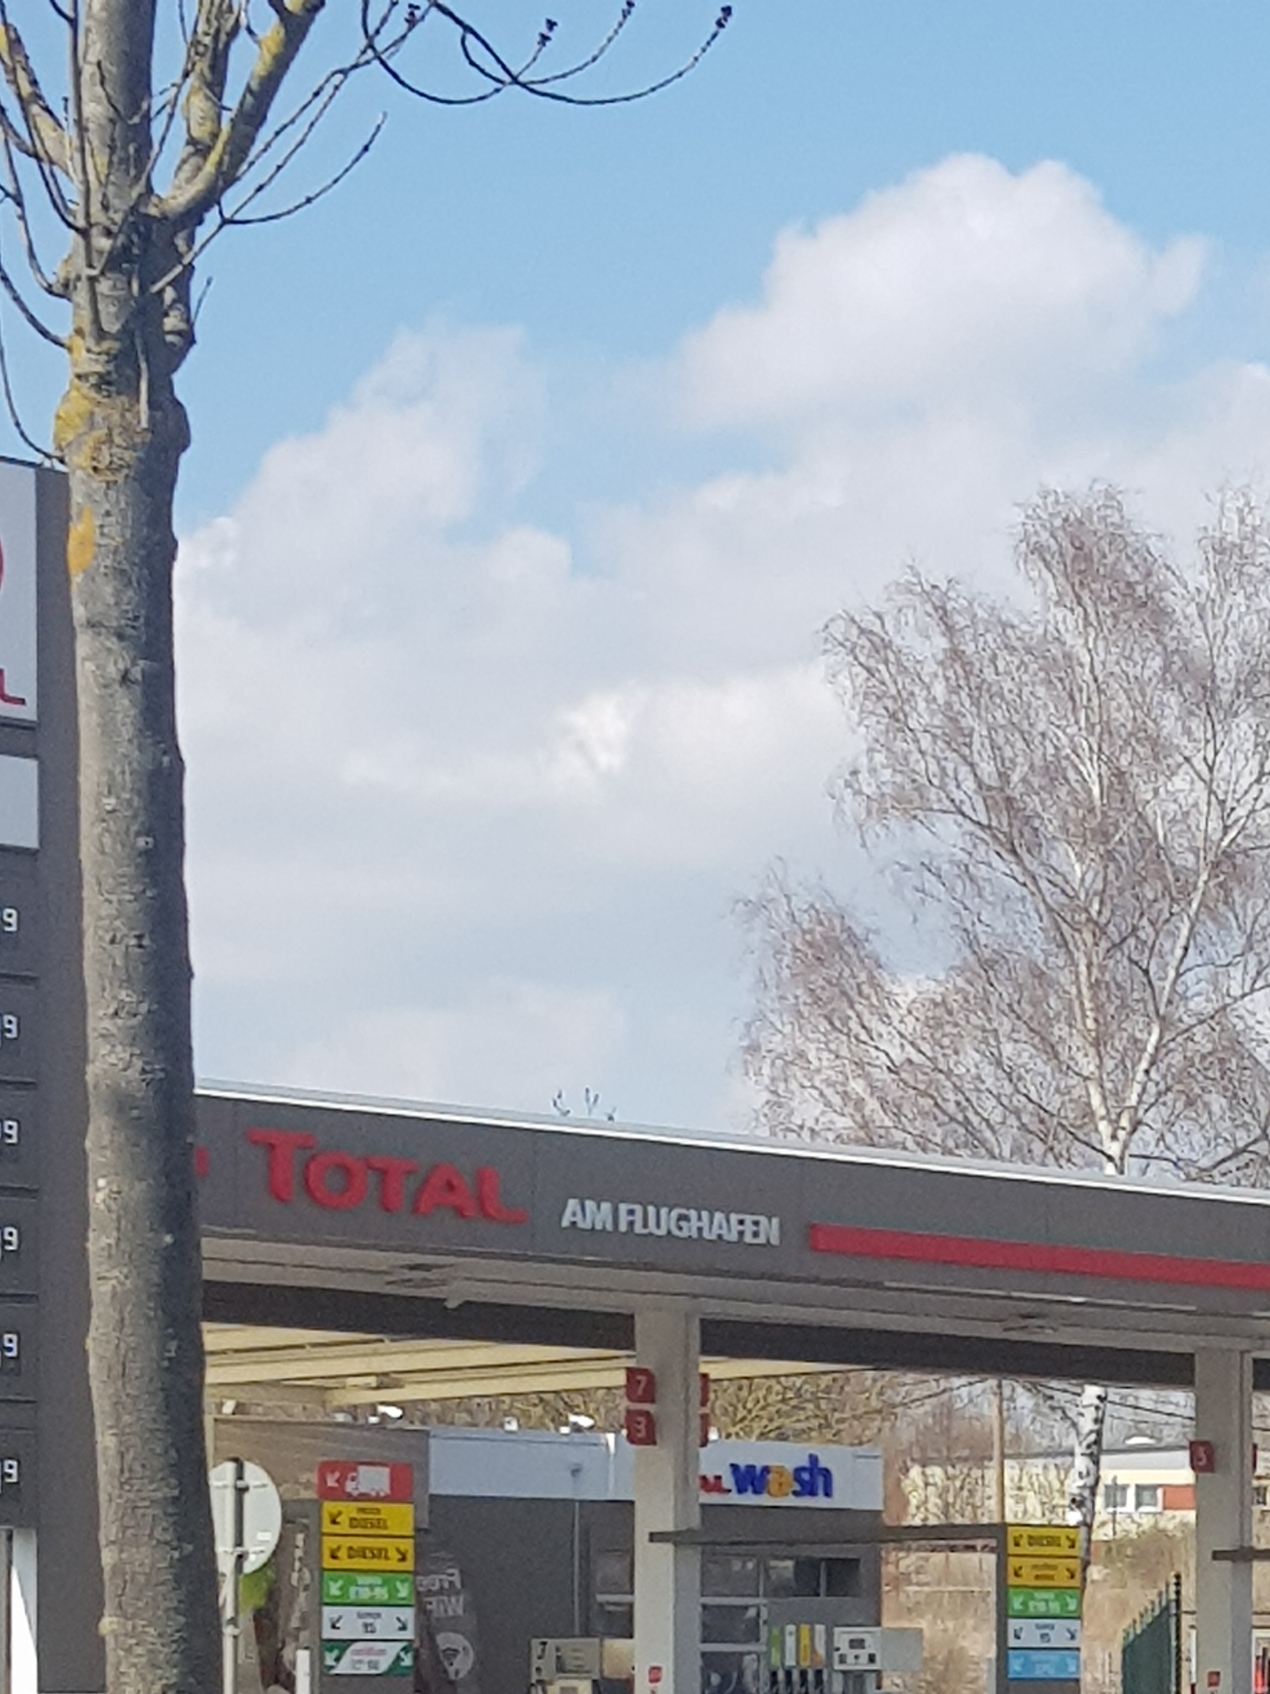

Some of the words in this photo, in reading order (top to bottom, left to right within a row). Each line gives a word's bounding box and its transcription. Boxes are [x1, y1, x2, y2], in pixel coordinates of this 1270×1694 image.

[561, 1198, 614, 1232] AM
[617, 1202, 781, 1246] FLUGHAFEN
[636, 1376, 649, 1397] 7
[634, 1415, 647, 1438] 3
[730, 1452, 834, 1499] wash
